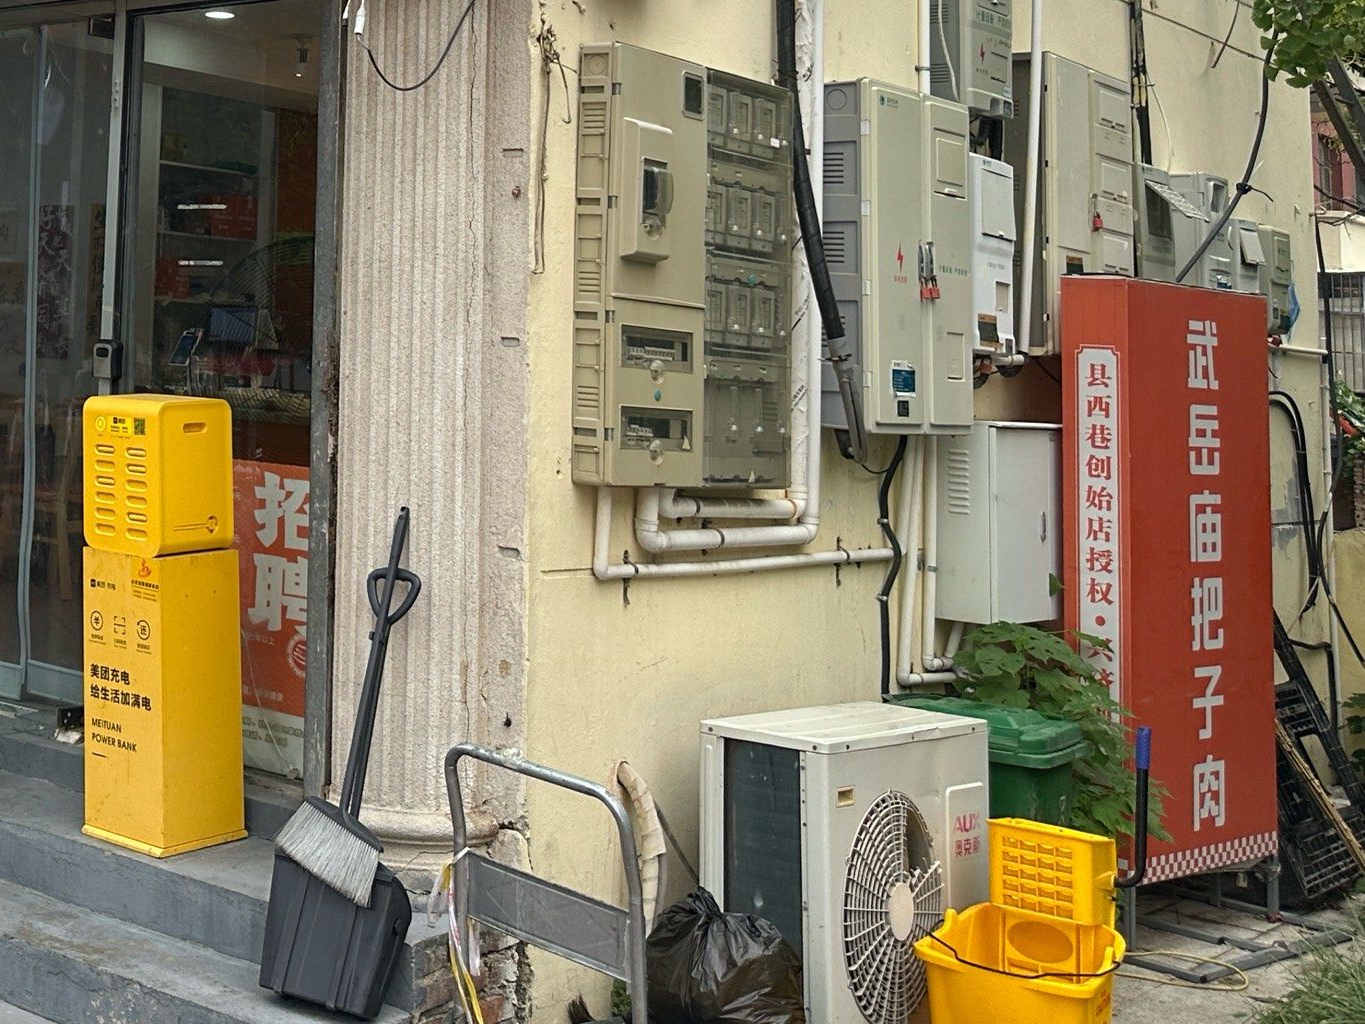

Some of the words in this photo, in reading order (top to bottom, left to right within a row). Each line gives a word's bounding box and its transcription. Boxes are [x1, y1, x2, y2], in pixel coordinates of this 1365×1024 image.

[247, 470, 310, 638] 招聘
[1186, 319, 1226, 832] 武岳庙把子肉
[90, 663, 130, 685] 美团充电
[90, 684, 152, 711] 给生活加满电
[91, 718, 122, 733] MEITUAN
[91, 732, 116, 748] POWER
[117, 739, 137, 752] BANK
